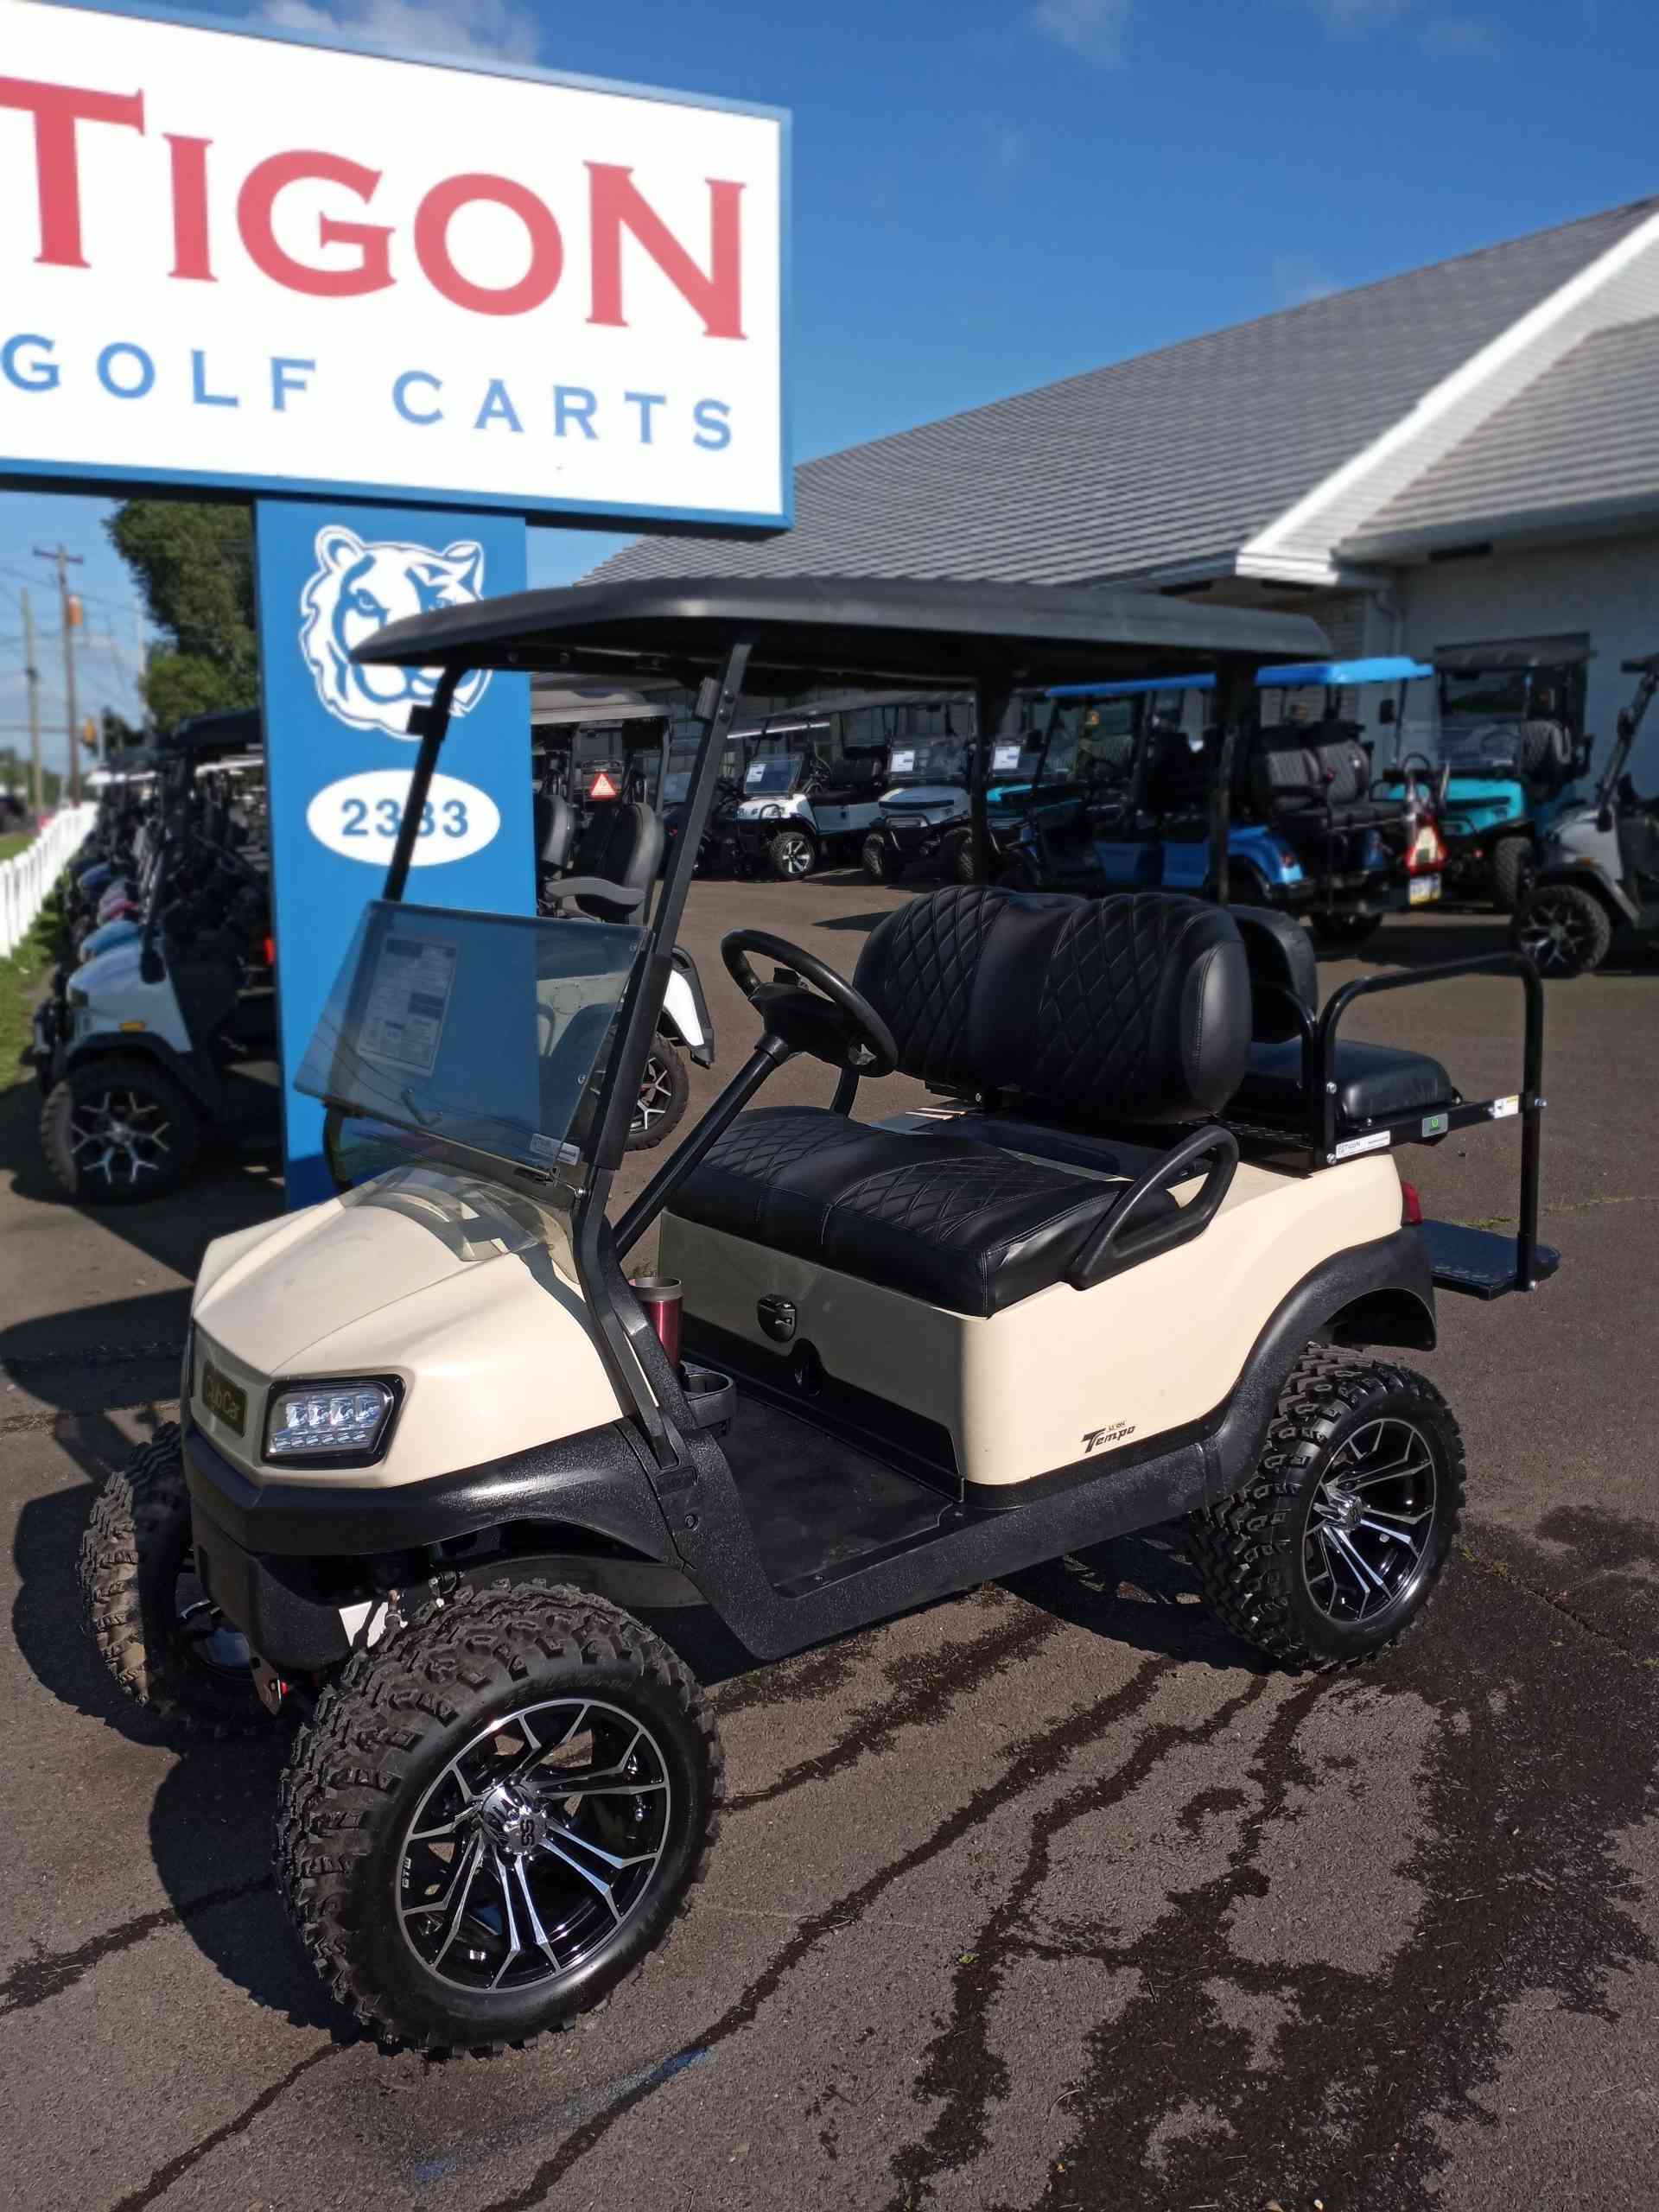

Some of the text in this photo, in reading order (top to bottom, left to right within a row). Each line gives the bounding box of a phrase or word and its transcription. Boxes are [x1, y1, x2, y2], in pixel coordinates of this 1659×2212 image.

[0, 75, 748, 341] TIGON
[0, 333, 734, 451] GOLF CARTS
[1080, 1426, 1135, 1453] Tempo
